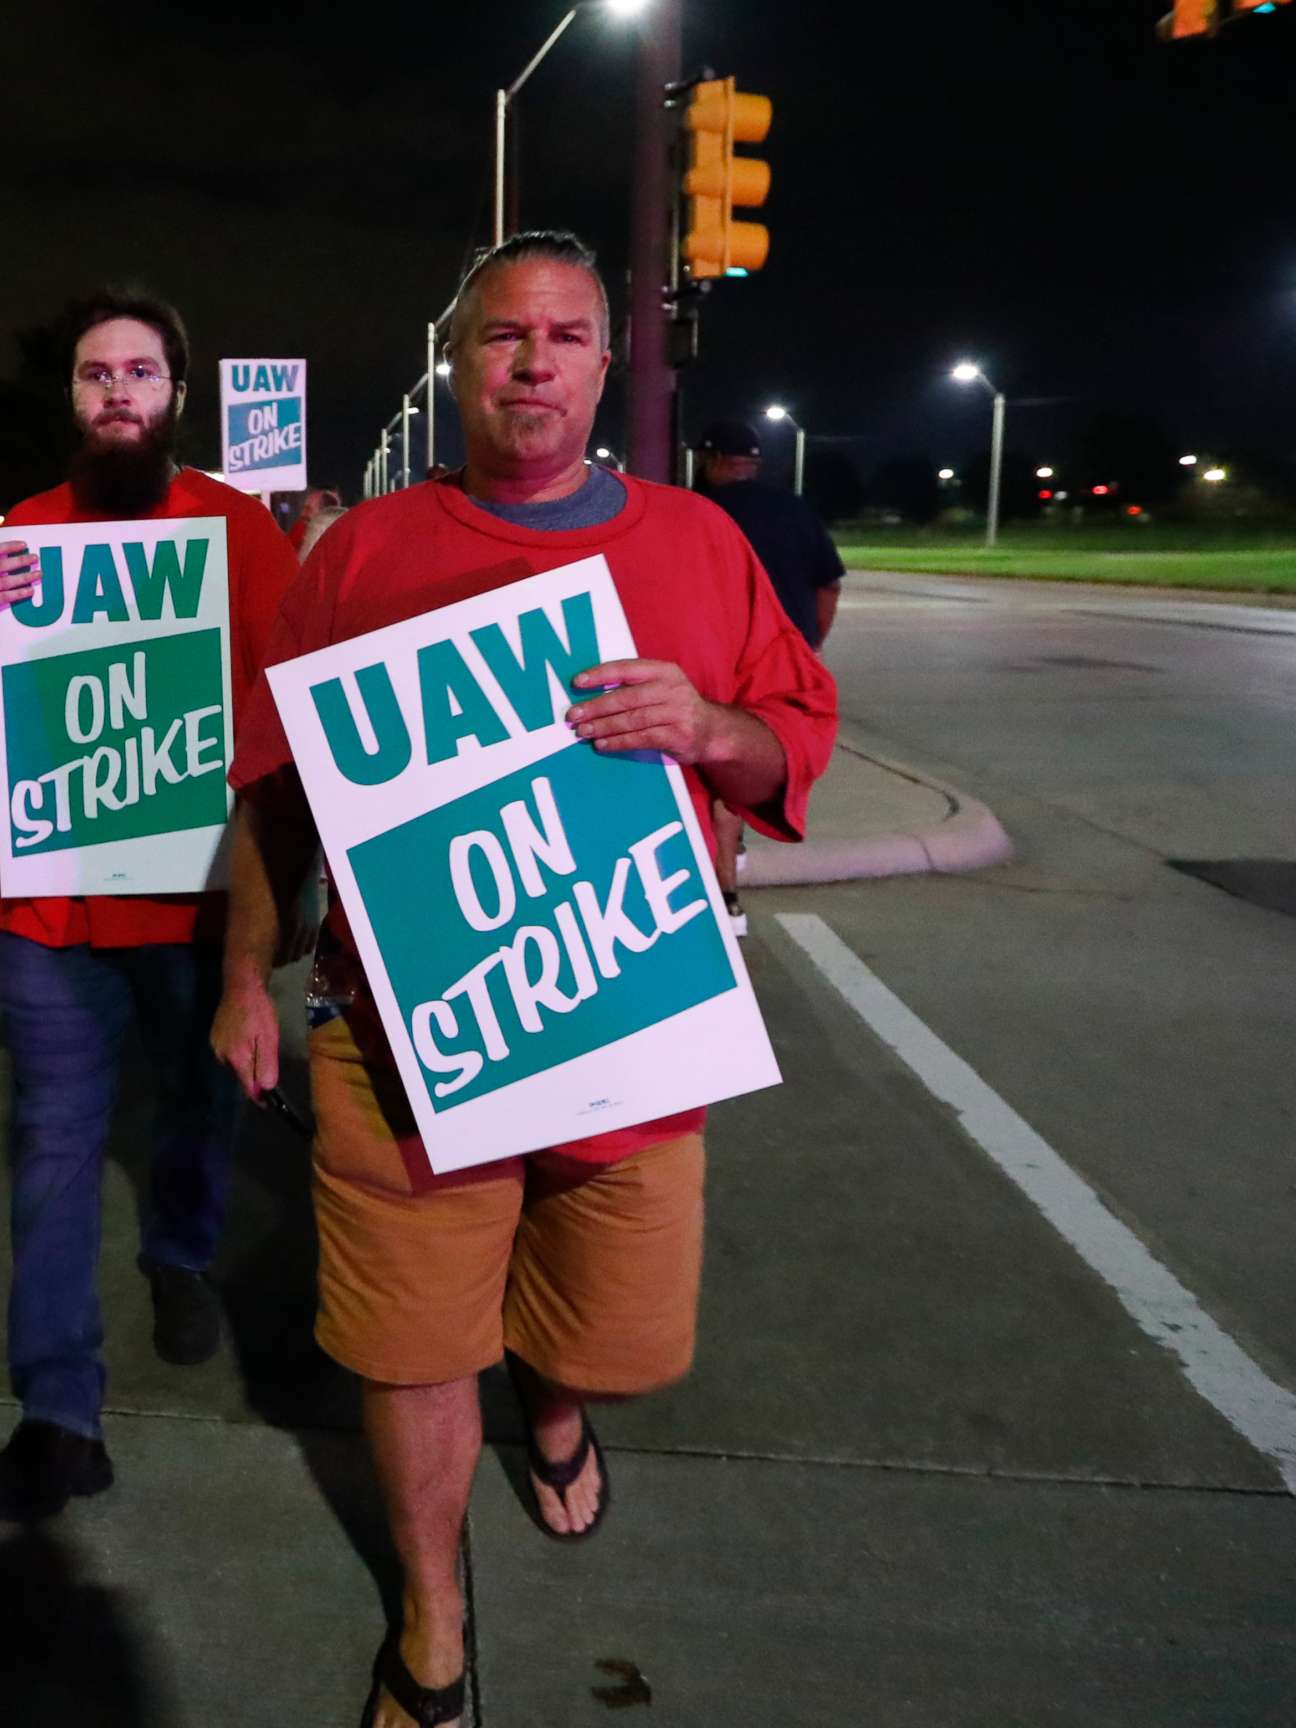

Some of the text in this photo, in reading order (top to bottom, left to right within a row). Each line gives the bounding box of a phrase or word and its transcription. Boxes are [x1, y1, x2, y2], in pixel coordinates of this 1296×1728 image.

[231, 364, 299, 393] UAW
[247, 401, 279, 436] ON
[228, 421, 302, 472] STRIKE
[64, 650, 148, 745] ON
[308, 590, 605, 787] UAW
[10, 703, 224, 849] STRIKE
[448, 776, 577, 933] ON
[409, 820, 709, 1098] STRIKE
